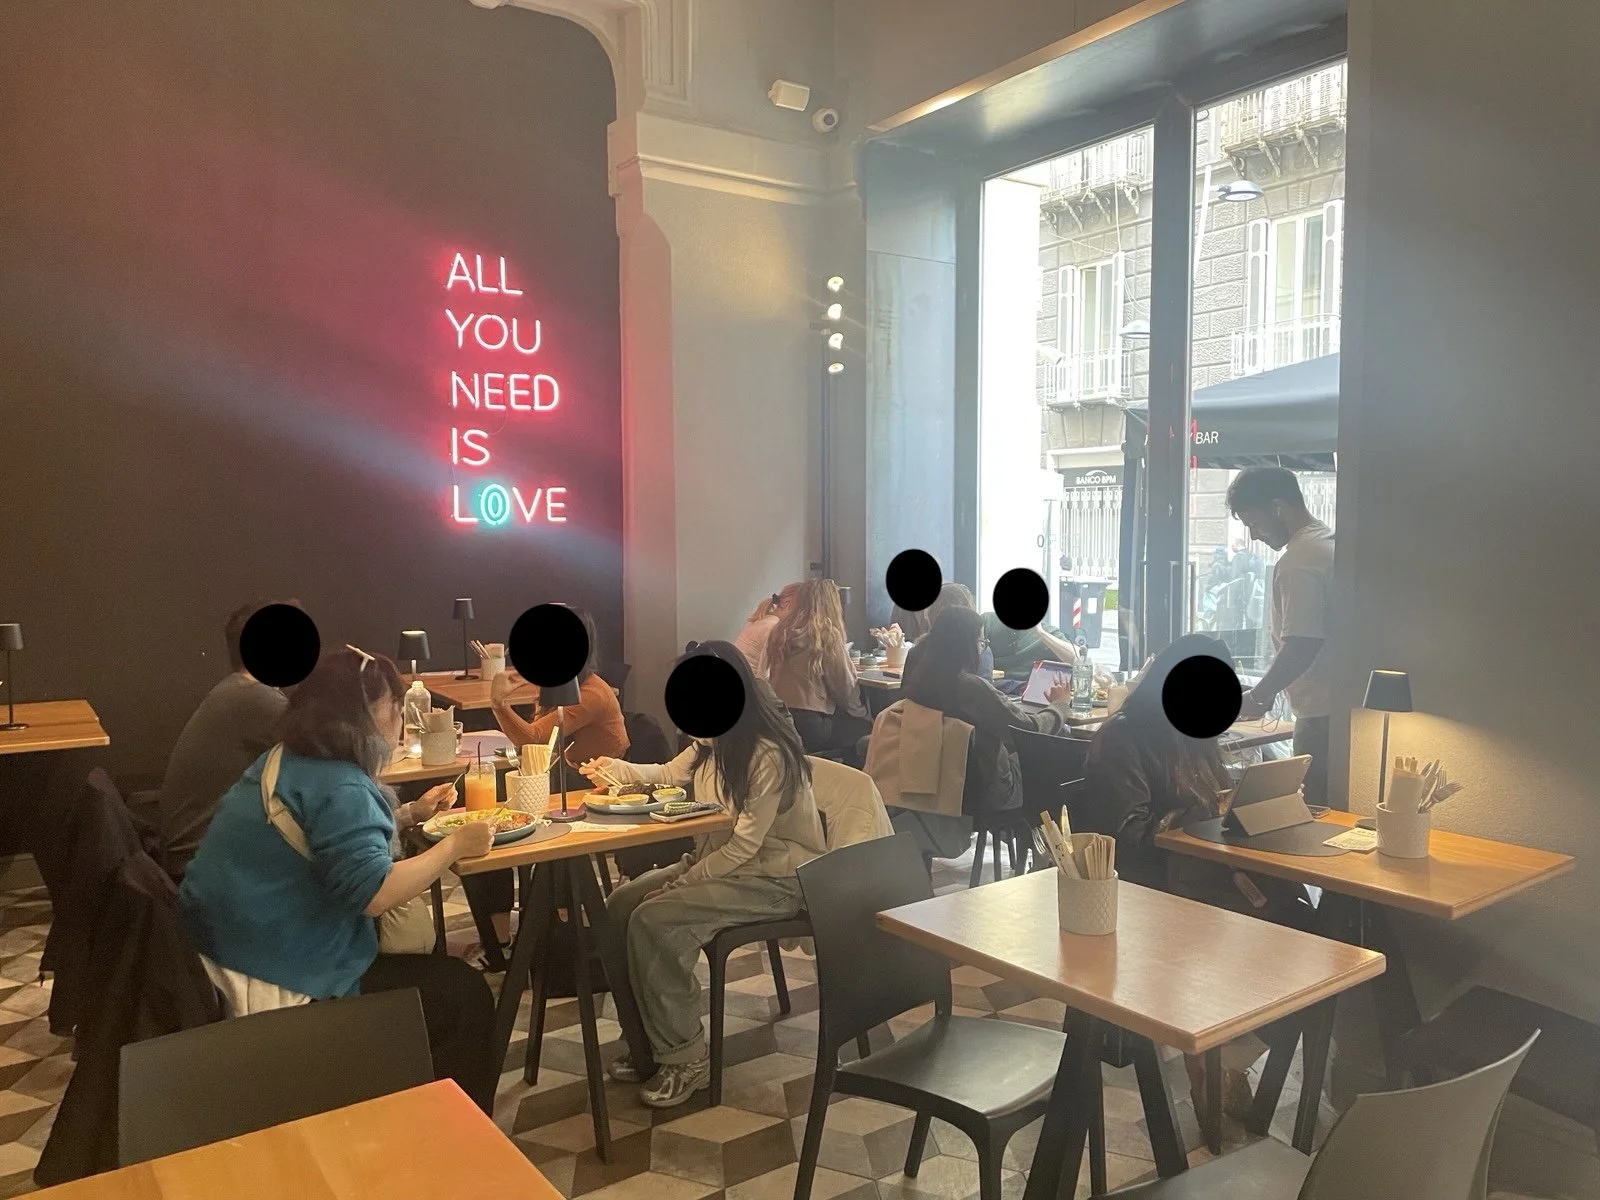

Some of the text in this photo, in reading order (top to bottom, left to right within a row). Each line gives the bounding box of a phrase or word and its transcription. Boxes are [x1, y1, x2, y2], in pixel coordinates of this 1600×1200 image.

[446, 252, 523, 296] ALL
[445, 308, 541, 354] YOU
[451, 370, 559, 411] NEED
[451, 427, 490, 466] IS
[1195, 430, 1219, 445] BAR
[1076, 475, 1117, 485] BANCO BPM
[453, 483, 567, 526] LOVE
